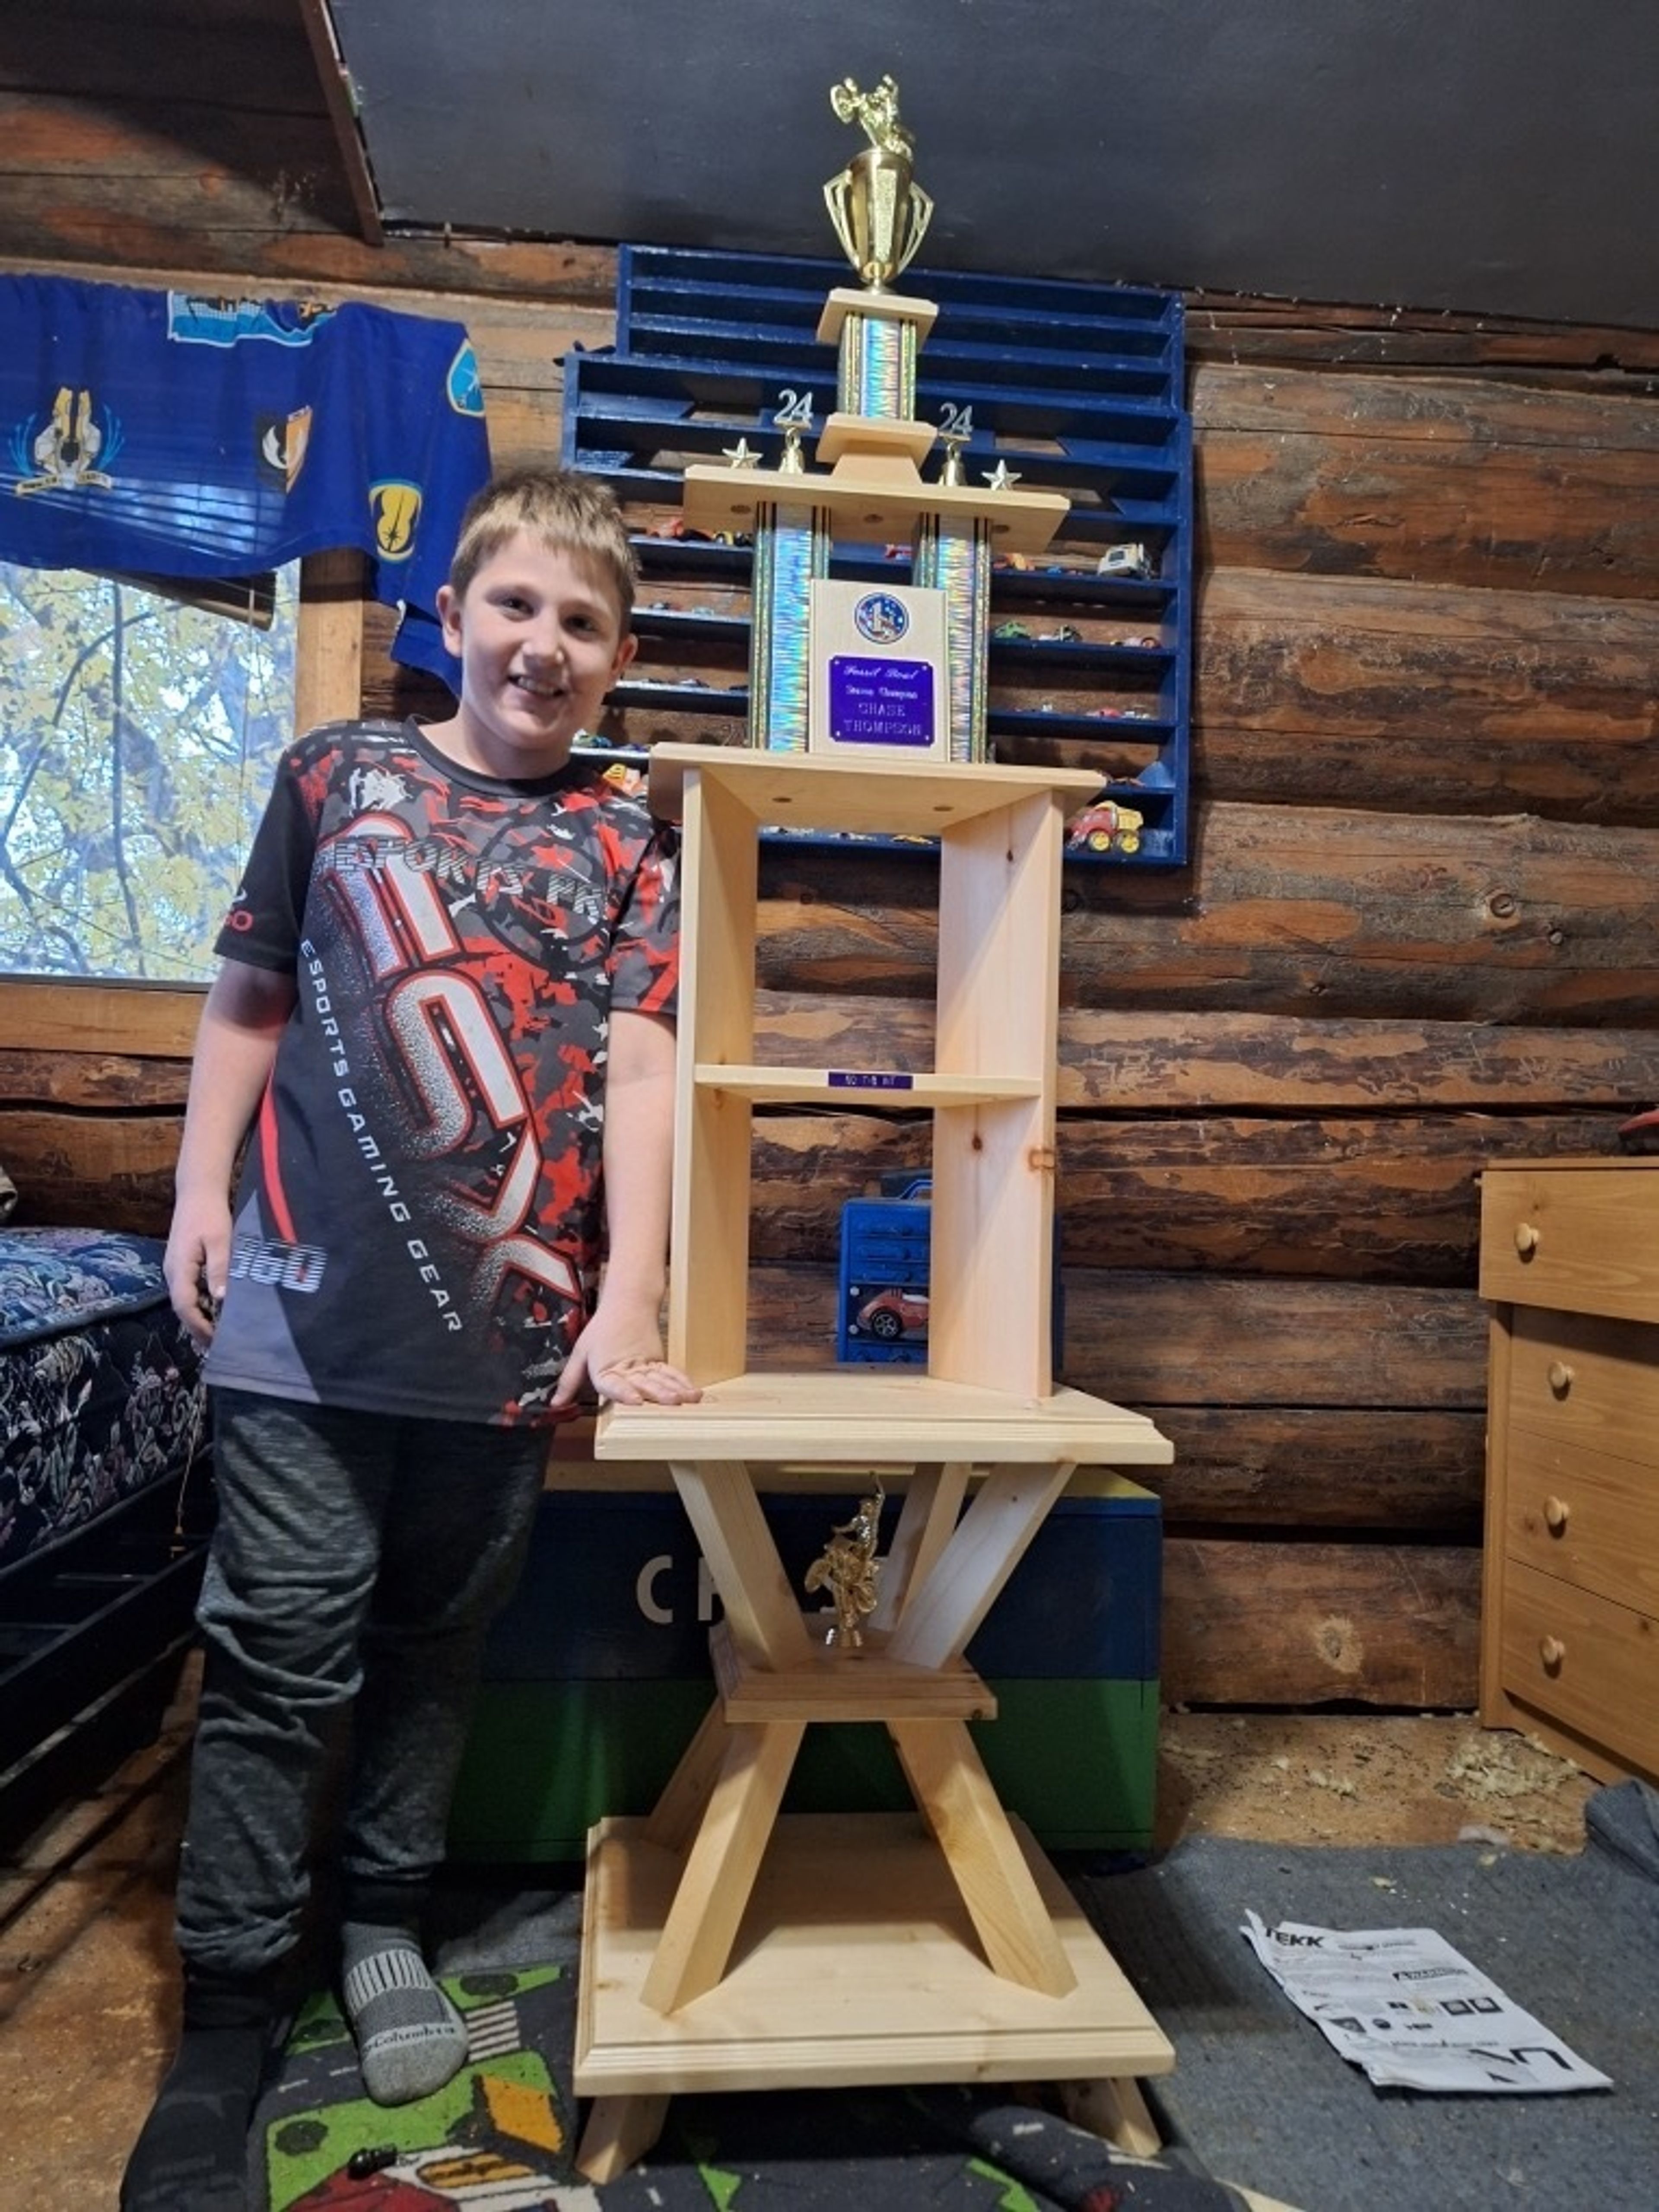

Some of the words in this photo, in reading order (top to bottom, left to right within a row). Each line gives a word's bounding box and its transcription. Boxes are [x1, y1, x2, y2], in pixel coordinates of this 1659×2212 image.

[773, 388, 813, 422] 24
[938, 403, 973, 433] 24
[858, 702, 906, 717] CHASE
[844, 719, 921, 735] THOMPSON
[300, 938, 351, 1077] ESPORTS
[336, 1087, 411, 1224] GAMING
[406, 1238, 464, 1333] GEAR
[375, 2025, 456, 2048] Columbia
